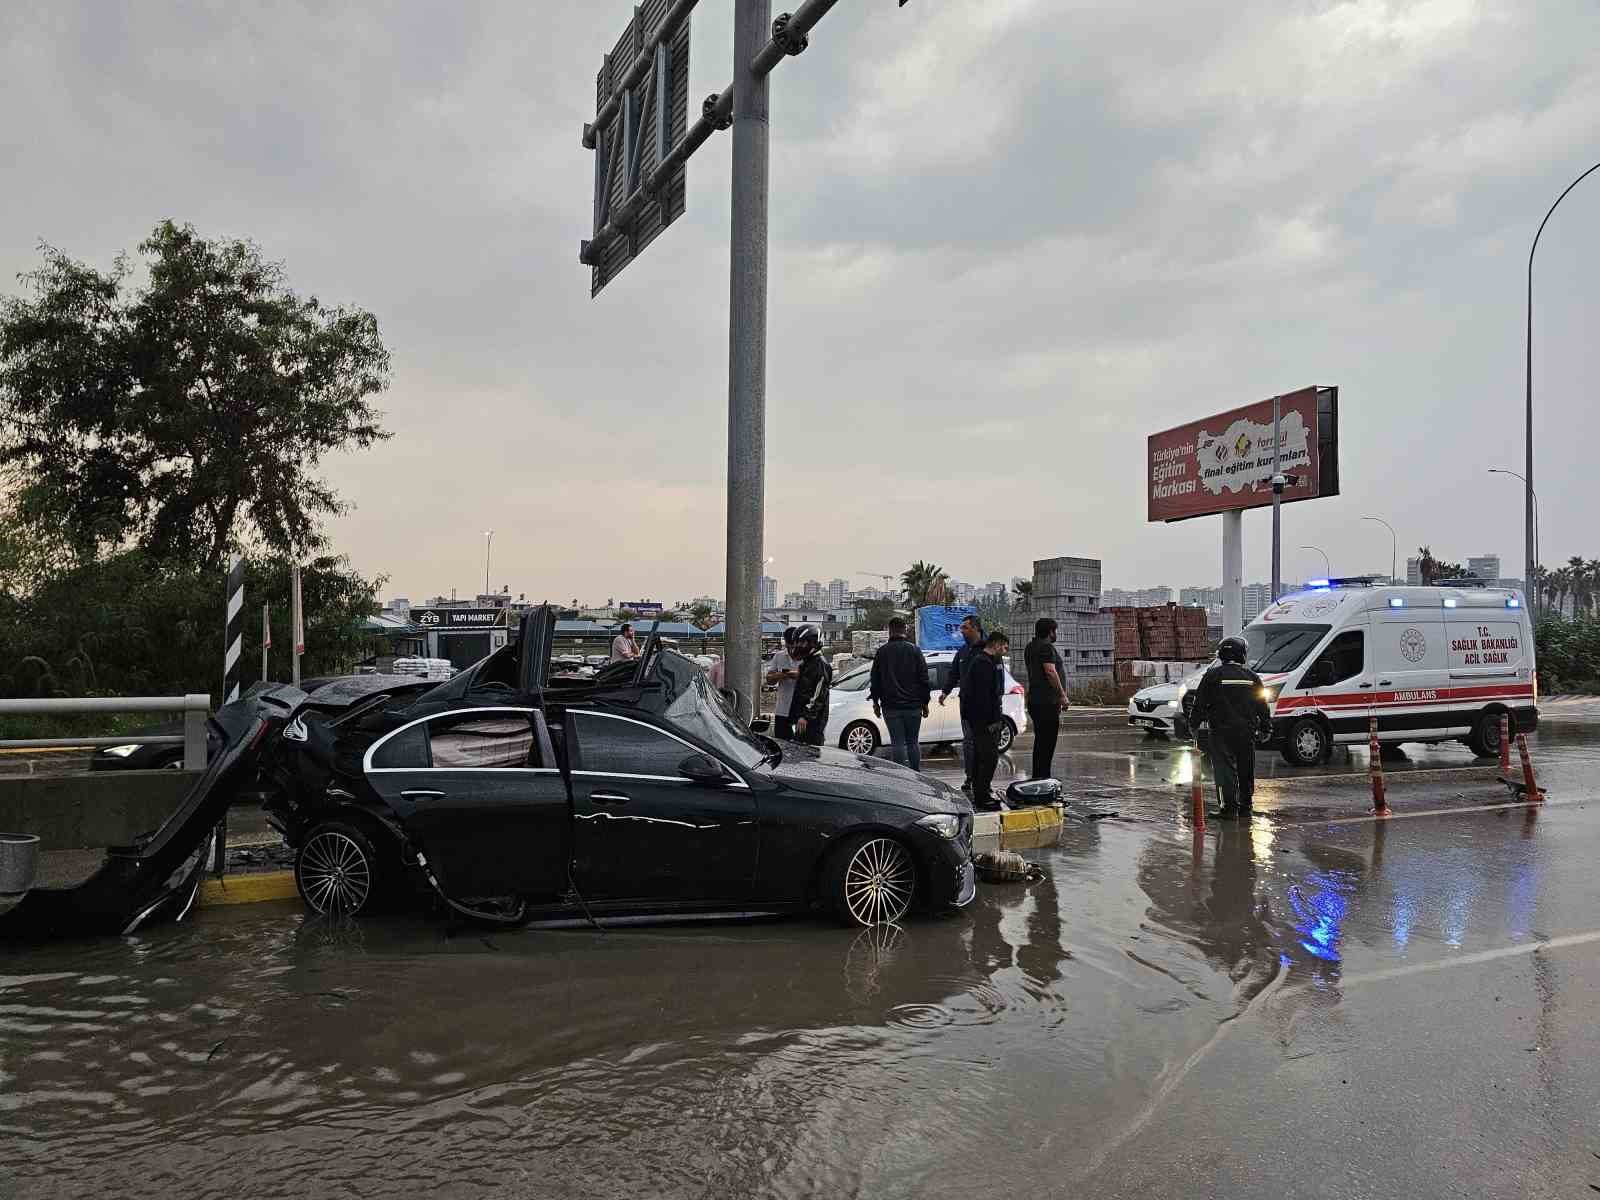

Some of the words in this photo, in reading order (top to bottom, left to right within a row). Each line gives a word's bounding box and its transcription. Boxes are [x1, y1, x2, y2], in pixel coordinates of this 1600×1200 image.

[1204, 465, 1223, 478] final
[1225, 461, 1254, 475] eğitim
[1256, 449, 1306, 468] kurmları
[1153, 461, 1186, 483] Eğitim
[1153, 480, 1197, 499] Markası
[420, 615, 440, 623] ZYB
[451, 614, 467, 622] YAPI
[467, 613, 495, 622] MARKET
[1477, 626, 1491, 637] T.C.
[1451, 637, 1478, 651] SAĞLIK
[1481, 636, 1518, 650] BAKANLIĞI
[1483, 651, 1508, 664] SAĞLIK
[1394, 690, 1437, 702] AMBULANS
